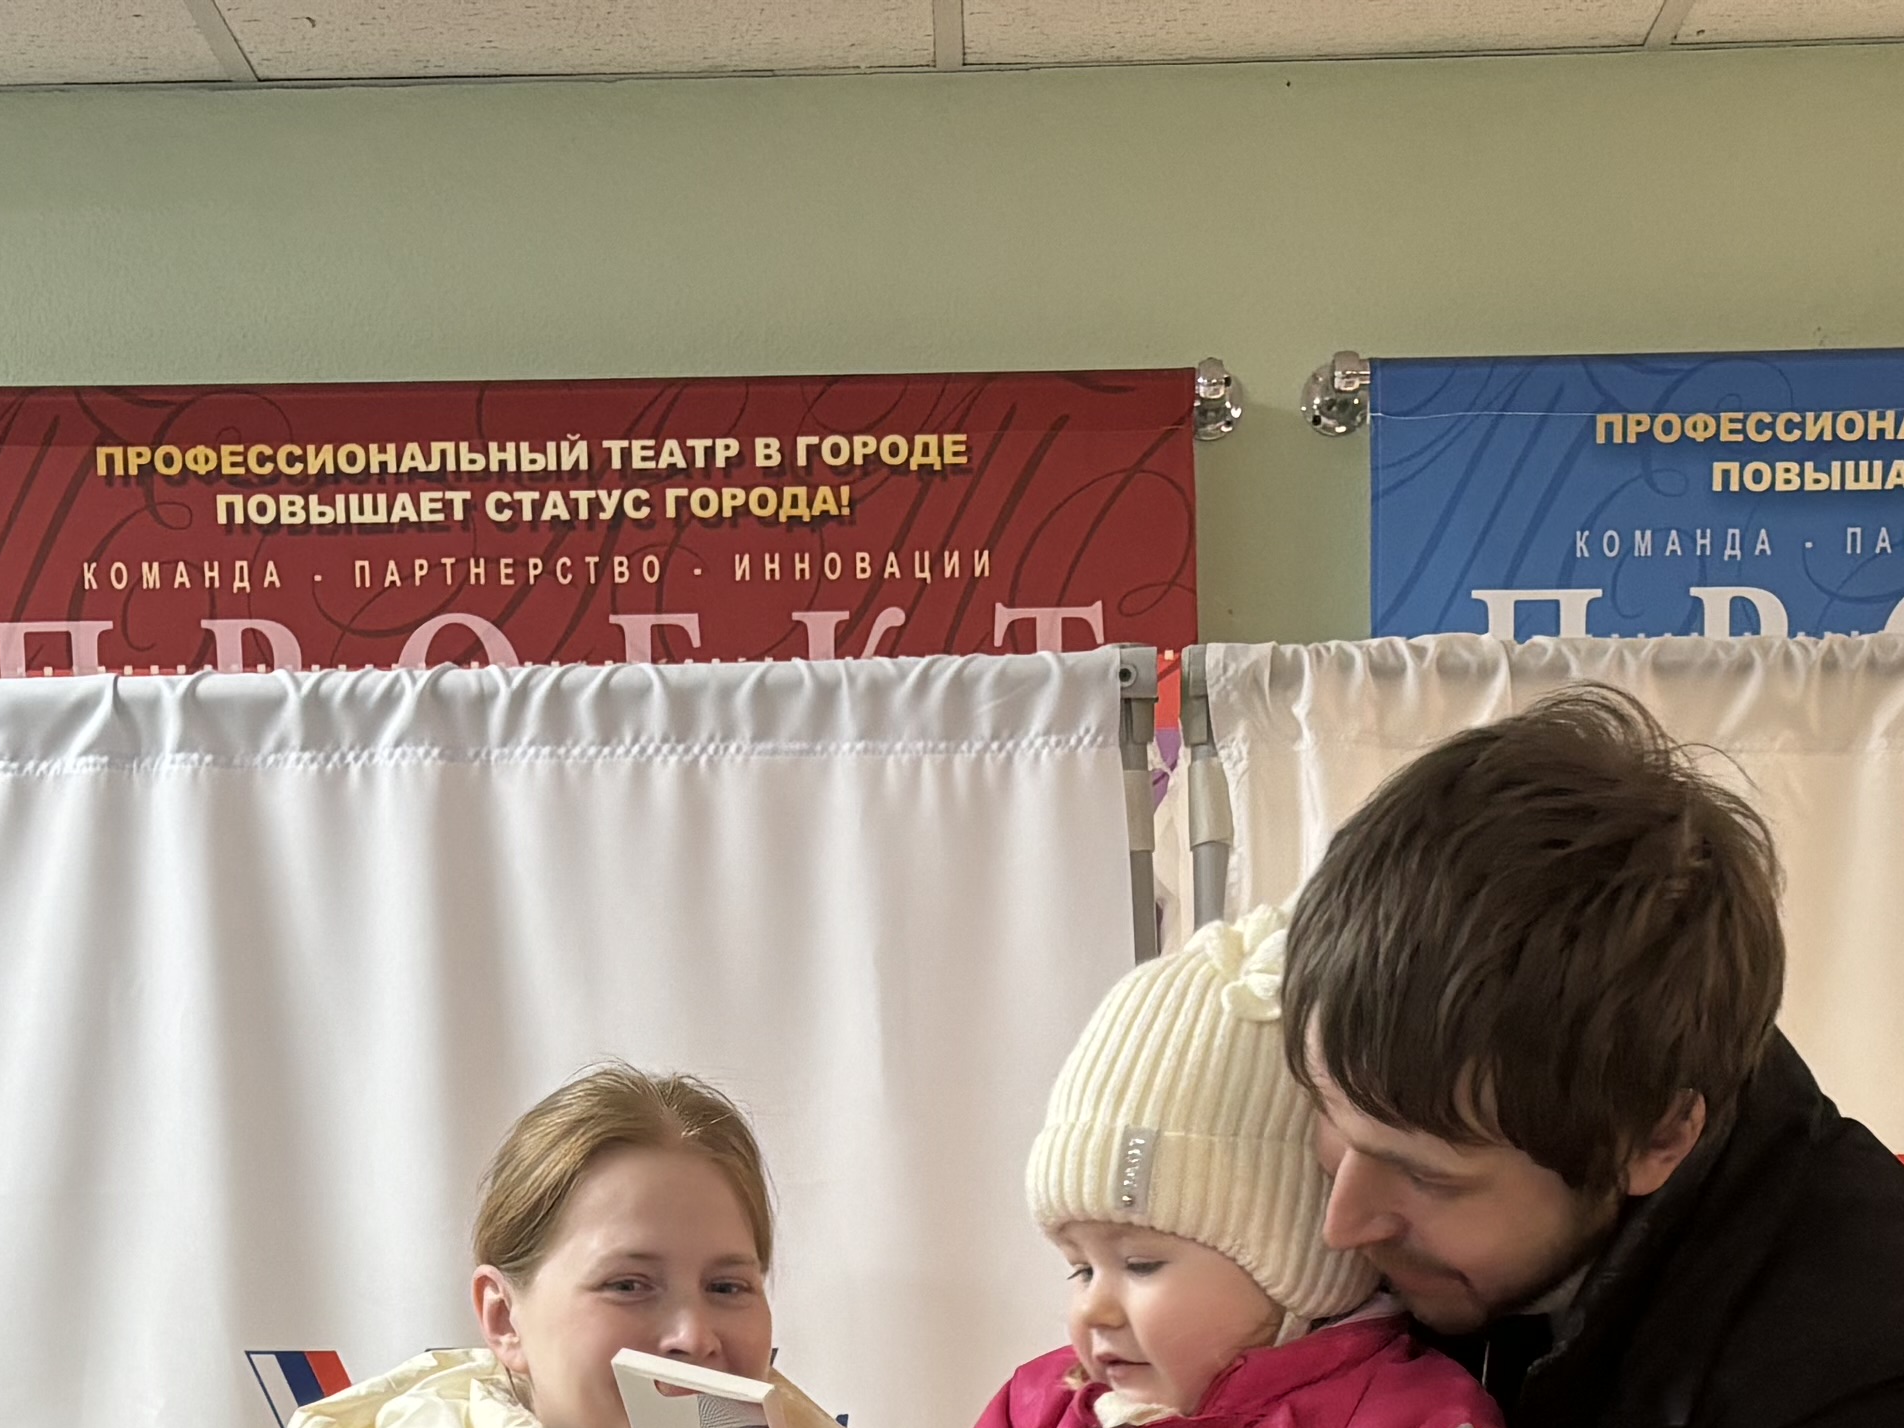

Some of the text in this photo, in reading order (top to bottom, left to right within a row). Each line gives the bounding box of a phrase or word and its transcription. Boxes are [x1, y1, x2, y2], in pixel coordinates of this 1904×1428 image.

[97, 434, 967, 475] ПРОФЕССИОНАЛЬНЫЙ ТЕАТР В ГОРОДЕ
[217, 486, 849, 524] ПОВЫШАЕТ СТАТУС ГОРОДА!
[1576, 529, 1771, 560] КОМАНДА
[84, 550, 989, 593] КОМАНДА ПАРТНЕРСТВО ИННОВАЦИИ
